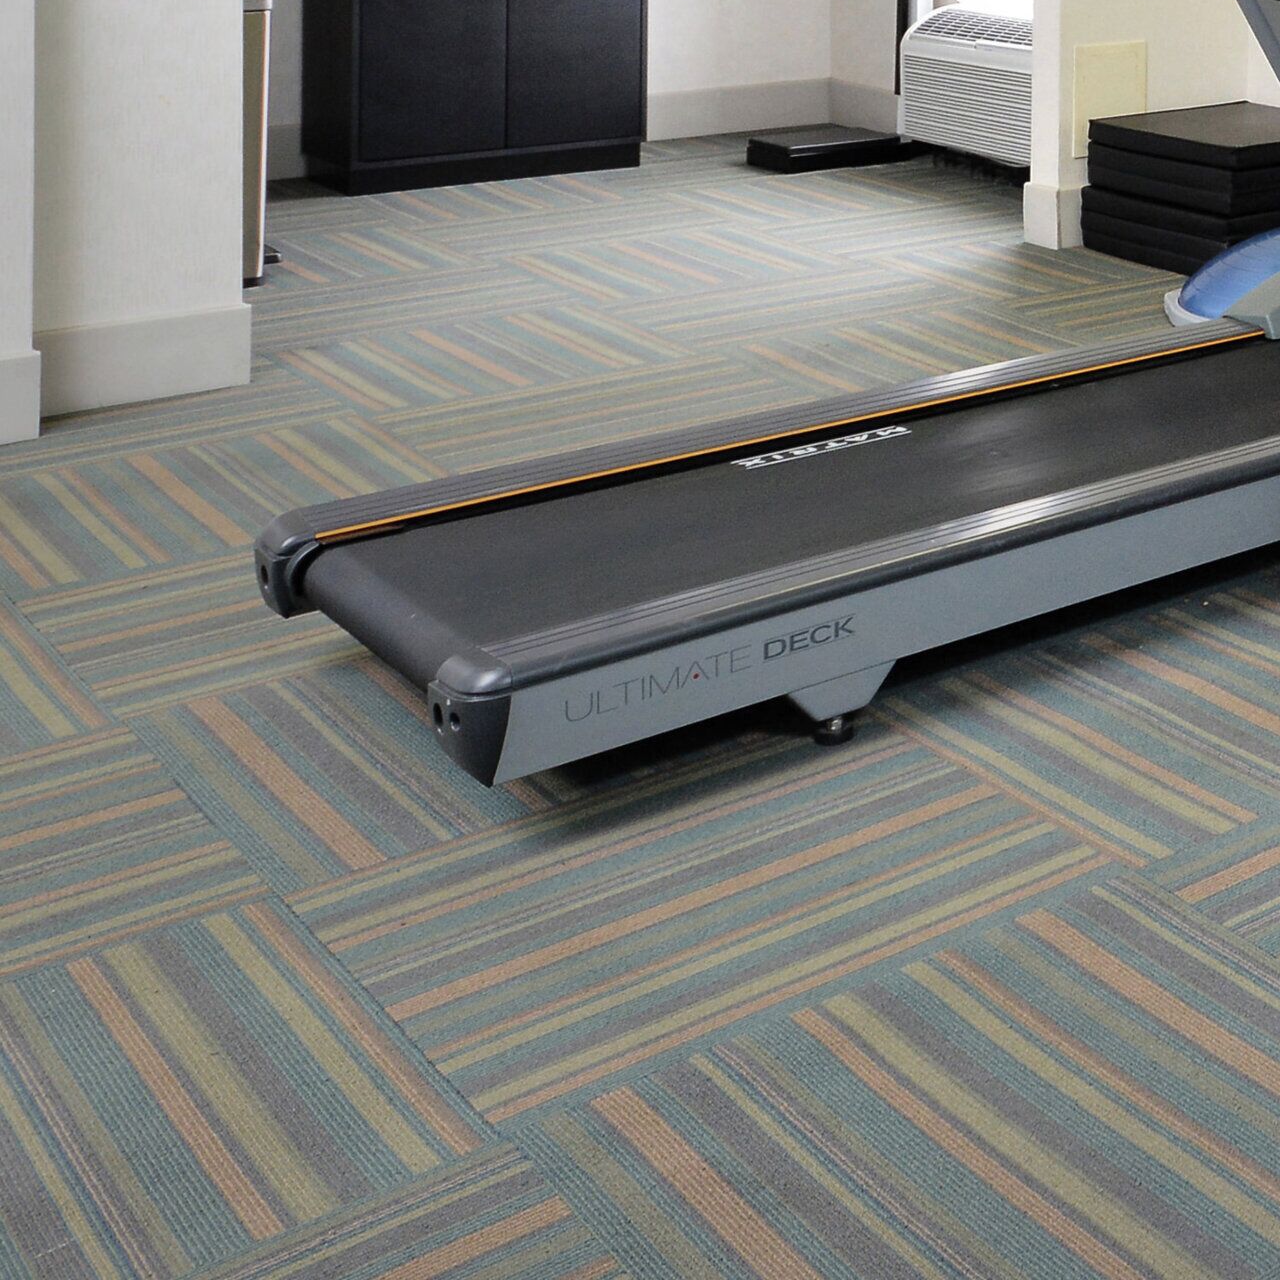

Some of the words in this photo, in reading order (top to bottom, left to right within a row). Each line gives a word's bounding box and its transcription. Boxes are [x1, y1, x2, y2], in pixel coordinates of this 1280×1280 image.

[738, 426, 908, 468] MATRIX
[565, 644, 751, 722] ULTIMATE
[763, 616, 855, 662] DECK
